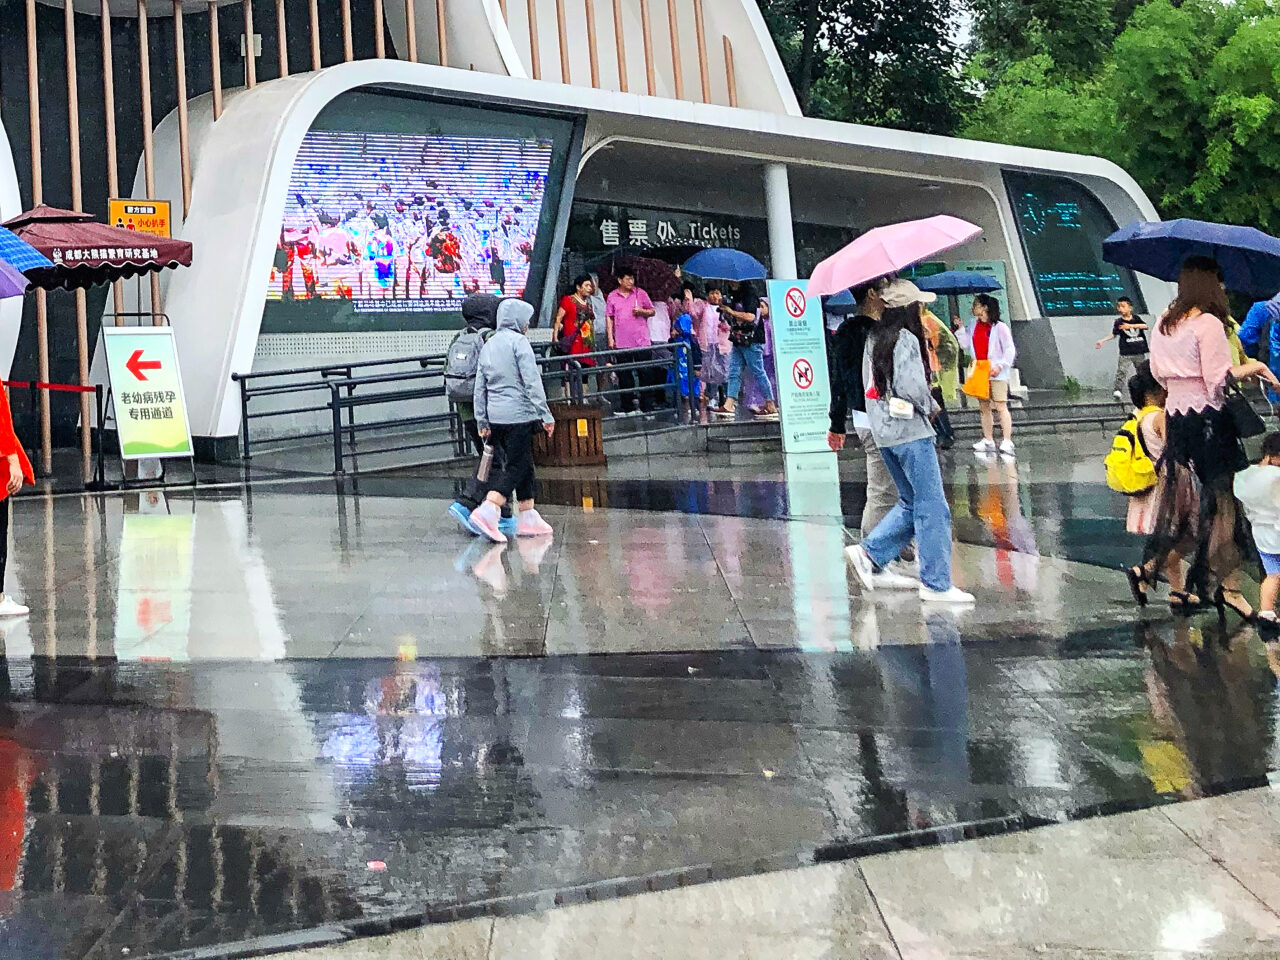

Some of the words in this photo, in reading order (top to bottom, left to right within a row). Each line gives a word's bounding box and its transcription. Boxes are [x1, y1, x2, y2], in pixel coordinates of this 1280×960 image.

[137, 218, 165, 227] 小心扒手
[688, 222, 741, 240] Tickets
[65, 248, 158, 260] 成都大熊猫繁育研究基地
[121, 391, 176, 404] 老幼病残孕
[129, 407, 173, 420] 专用通道
